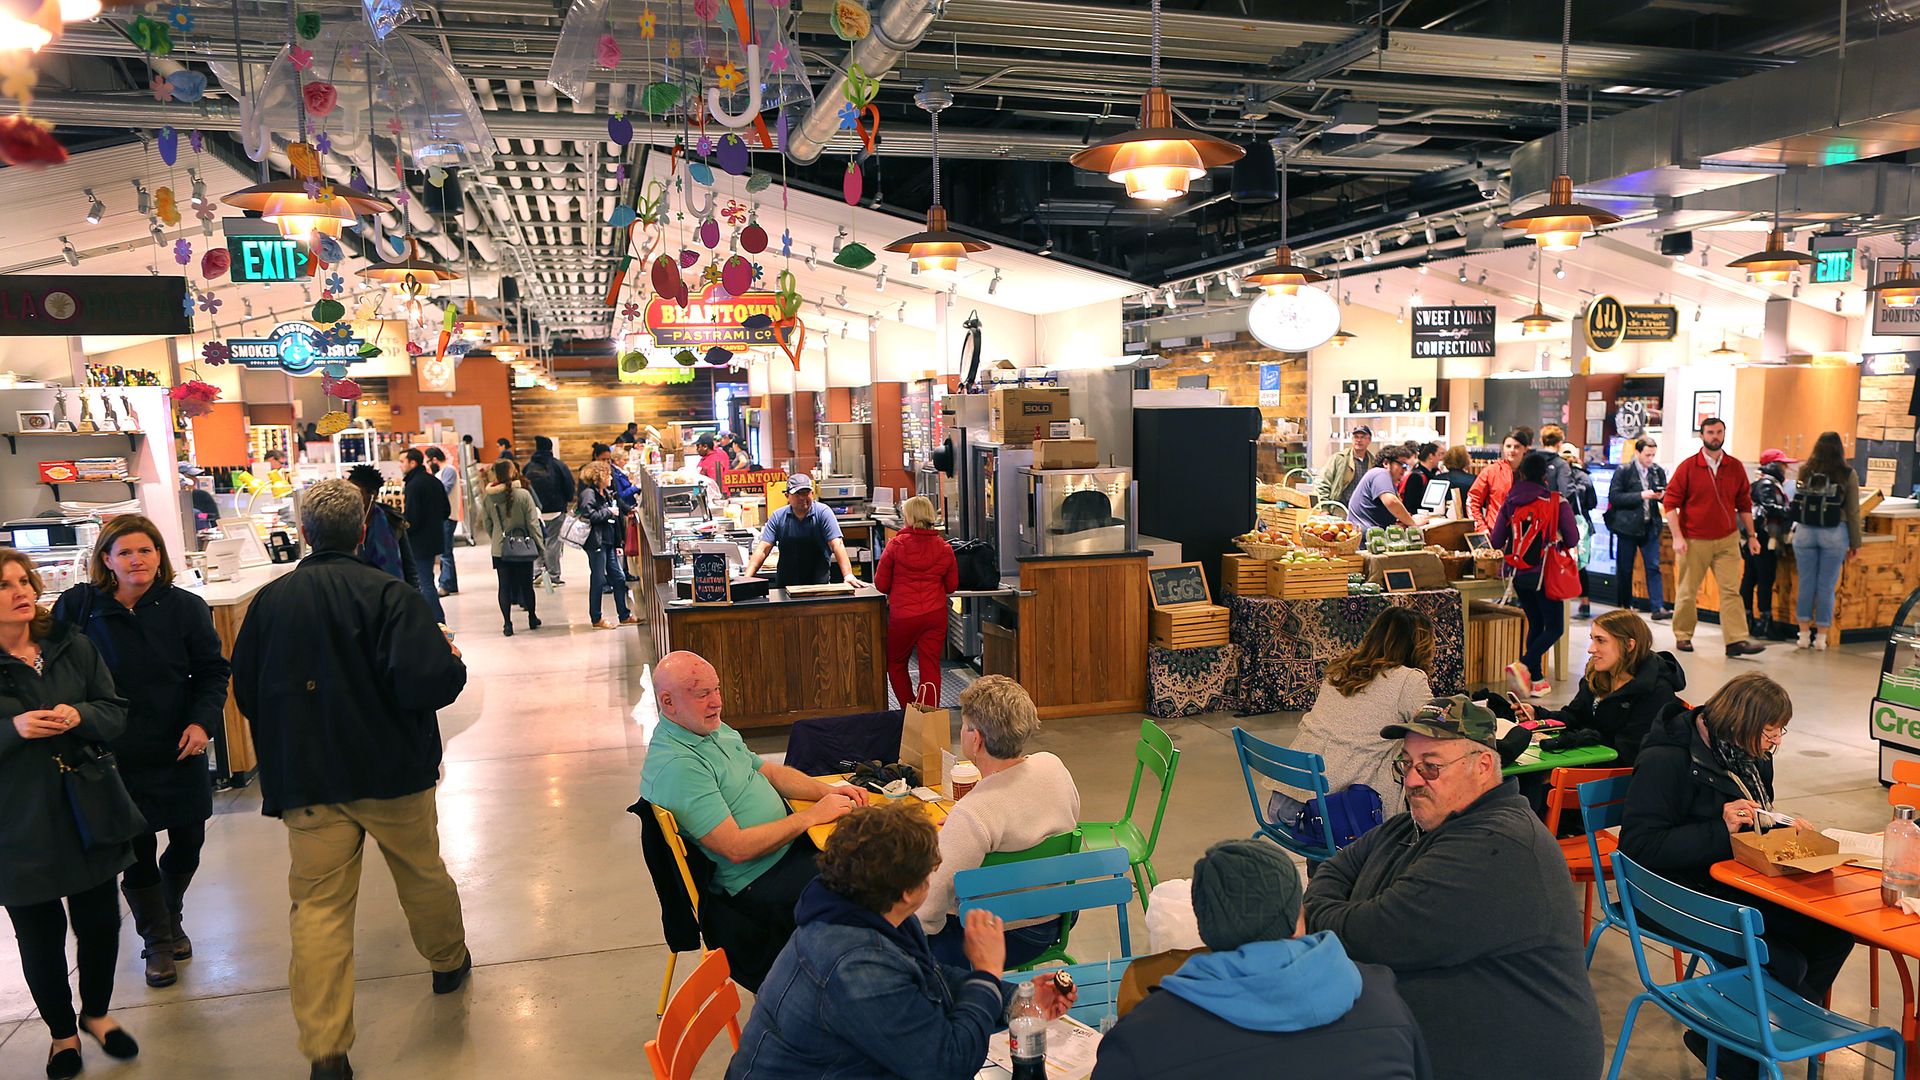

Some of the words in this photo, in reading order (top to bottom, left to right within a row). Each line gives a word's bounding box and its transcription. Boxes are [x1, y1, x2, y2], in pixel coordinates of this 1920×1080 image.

[242, 241, 297, 279] EXIT
[1817, 252, 1848, 282] EXIT
[661, 304, 782, 324] BEANTOWN
[1415, 310, 1451, 326] SWEET
[1453, 309, 1492, 325] LYDIA'S
[1881, 308, 1920, 323] DONUTS
[276, 324, 315, 337] BOSTON
[672, 330, 751, 341] PASTRAMI
[231, 344, 278, 358] SMOKED
[1415, 340, 1492, 356] CONFECTIONS
[1024, 405, 1050, 413] SOLO
[724, 471, 788, 485] BEANTOWN
[1151, 571, 1206, 603] EGGS
